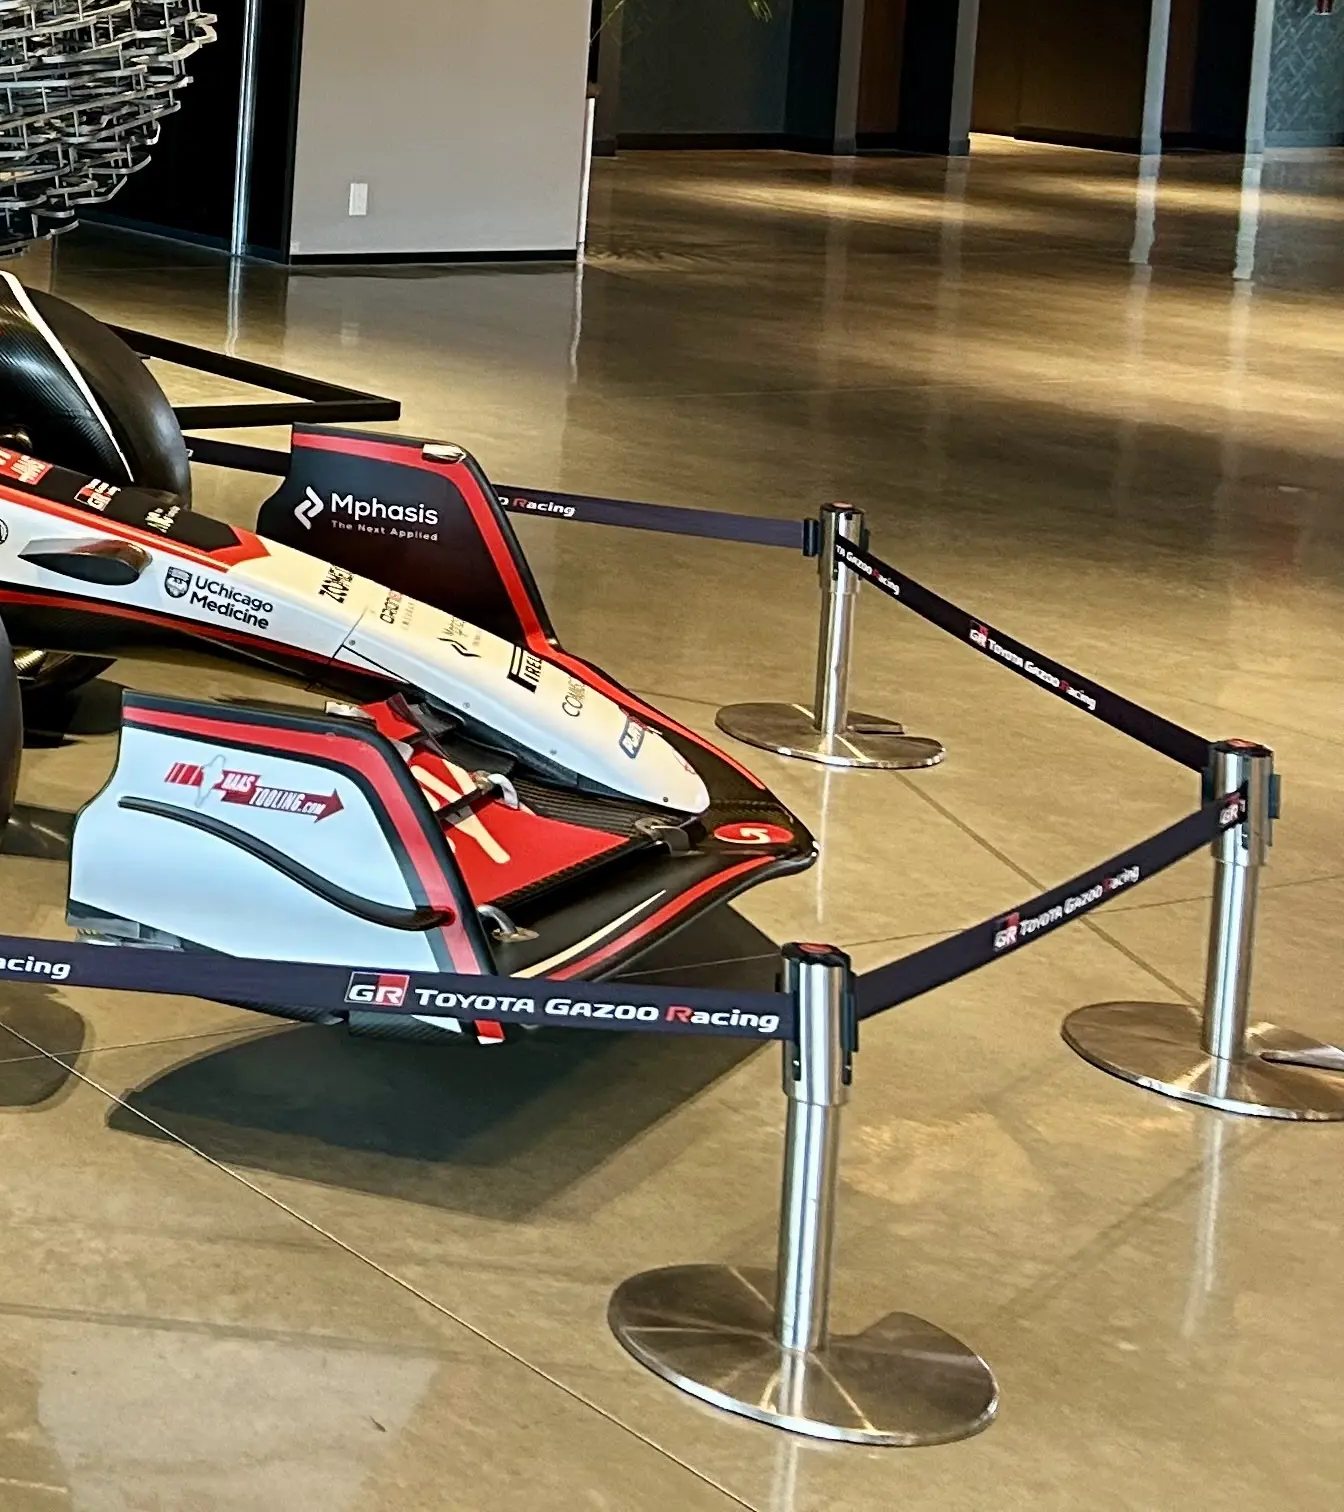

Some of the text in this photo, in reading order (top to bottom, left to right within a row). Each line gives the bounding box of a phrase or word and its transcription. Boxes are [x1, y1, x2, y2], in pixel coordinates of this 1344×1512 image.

[331, 492, 439, 526] Mphasis
[513, 497, 577, 518] Racing
[332, 519, 439, 542] The Next Applied
[190, 591, 270, 630] Medicine
[195, 575, 274, 613] UChicago
[1019, 905, 1063, 937] TOYOTA
[1064, 884, 1103, 915] GAZOO
[414, 987, 537, 1014] TOYOTA
[543, 997, 660, 1022] GAZOO
[665, 1004, 781, 1034] Racing
